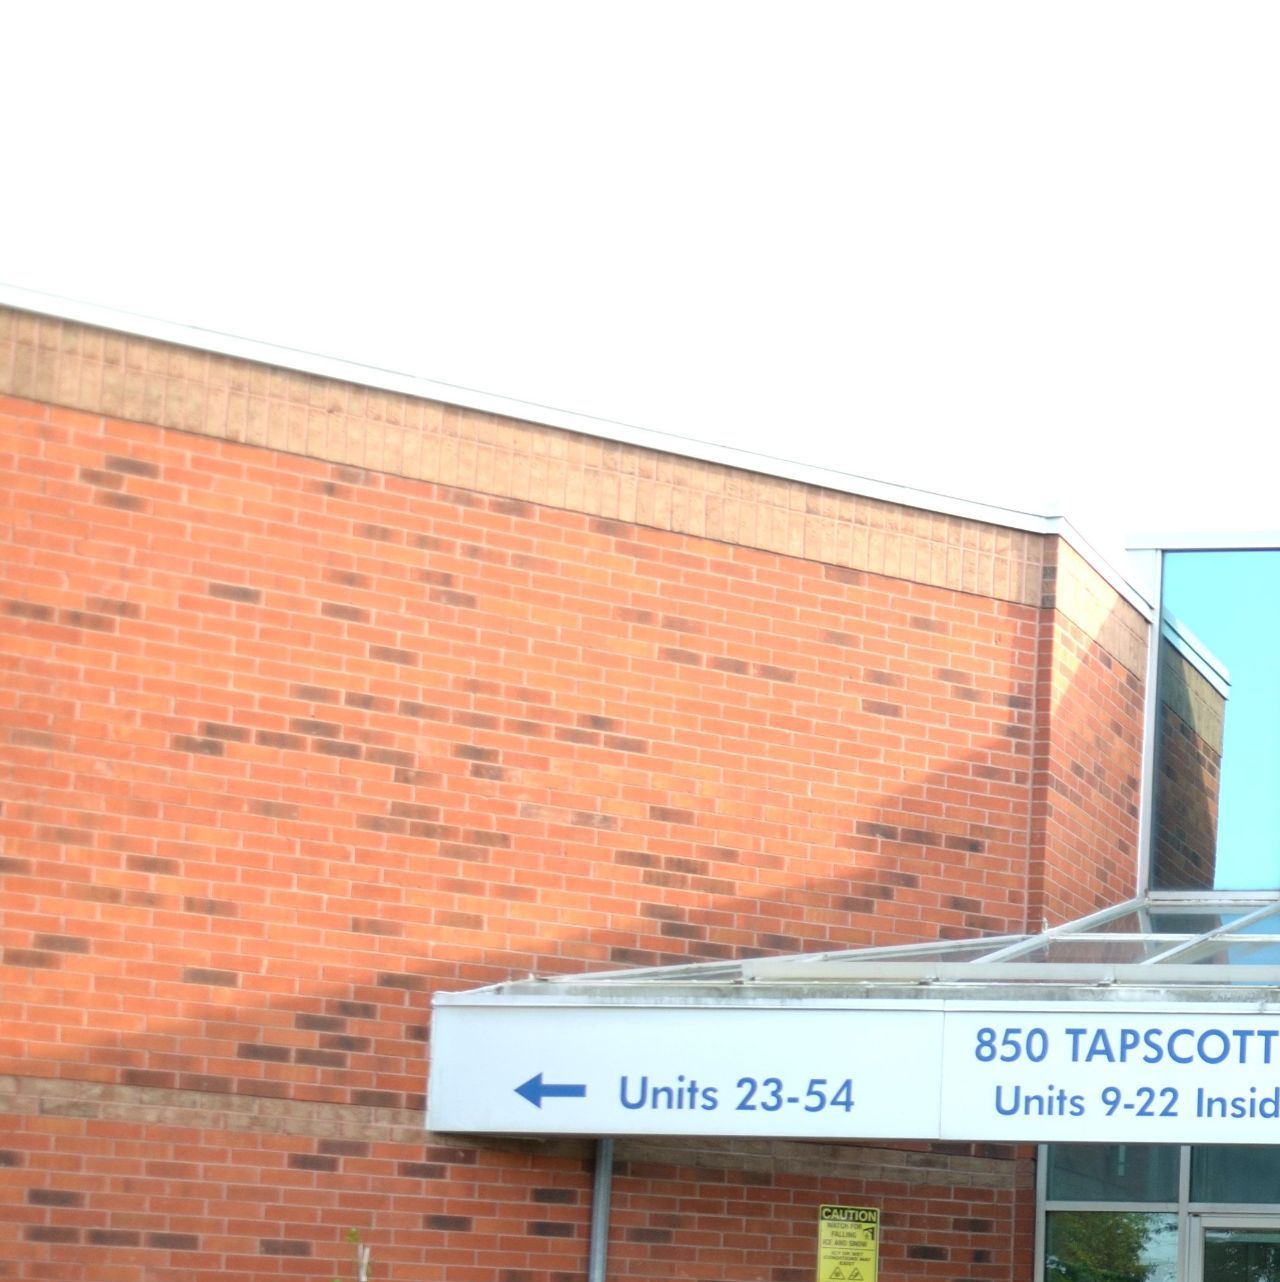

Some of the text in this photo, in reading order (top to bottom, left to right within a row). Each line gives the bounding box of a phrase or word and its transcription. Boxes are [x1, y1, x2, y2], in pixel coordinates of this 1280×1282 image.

[974, 1027, 1049, 1063] 850
[1065, 1028, 1279, 1065] TAPSCOTT
[619, 1074, 855, 1112] Units 23-54
[995, 1084, 1085, 1116] Units
[1101, 1086, 1179, 1117] 9-22
[823, 1208, 877, 1222] CAUTION
